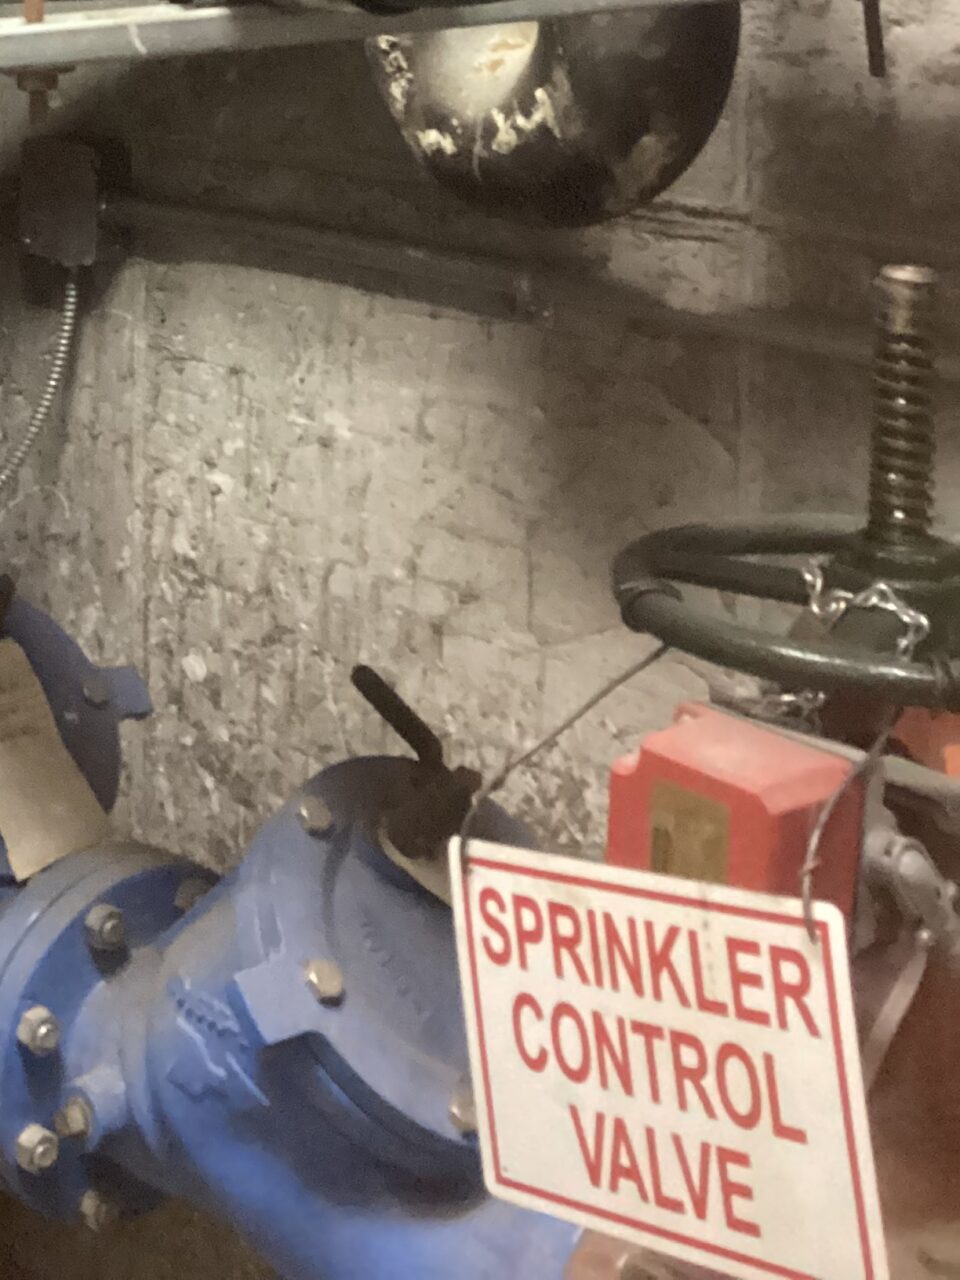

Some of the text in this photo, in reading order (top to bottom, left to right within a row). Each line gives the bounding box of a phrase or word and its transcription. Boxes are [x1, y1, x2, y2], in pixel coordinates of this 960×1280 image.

[478, 887, 822, 1038] SPRINKLER
[513, 992, 808, 1145] CONTROL
[569, 1103, 762, 1238] VALVE
